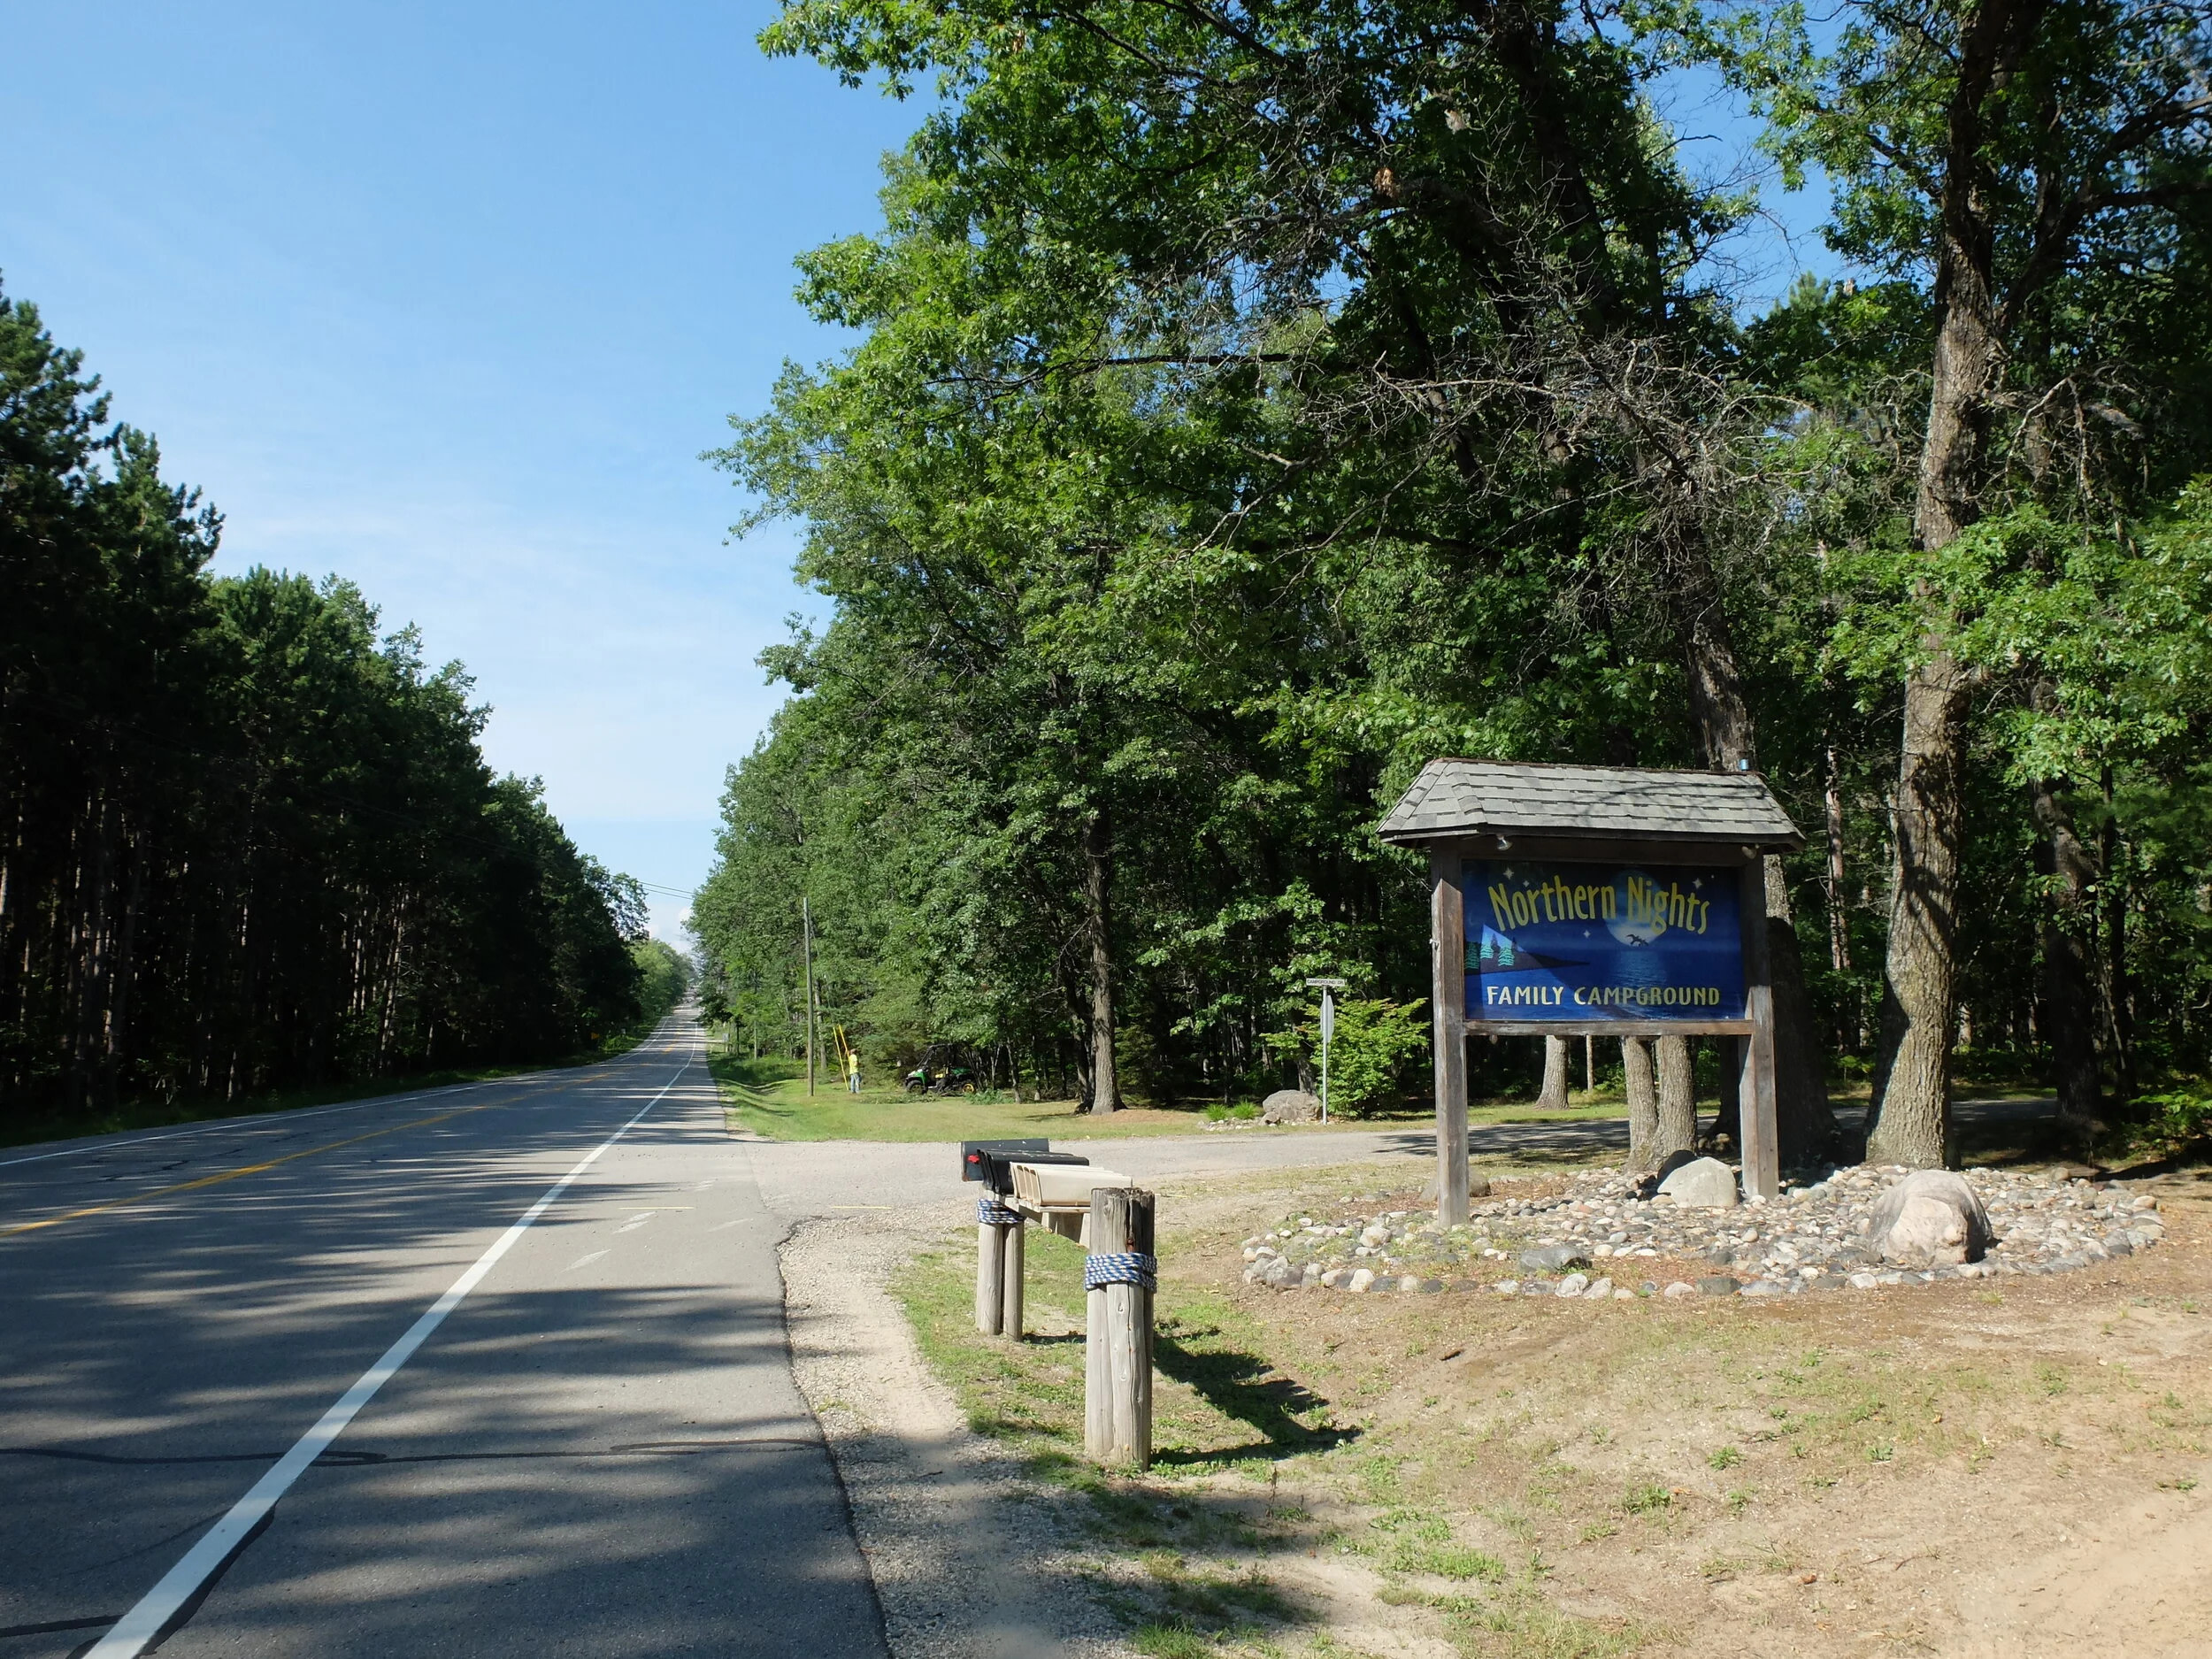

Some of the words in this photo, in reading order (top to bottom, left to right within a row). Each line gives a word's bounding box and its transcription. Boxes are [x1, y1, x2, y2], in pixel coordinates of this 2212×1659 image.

[1487, 875, 1617, 932] Northern
[1626, 876, 1710, 935] Nights
[1486, 986, 1564, 1005] FAMILY
[1573, 987, 1720, 1006] CAMPGROUND
